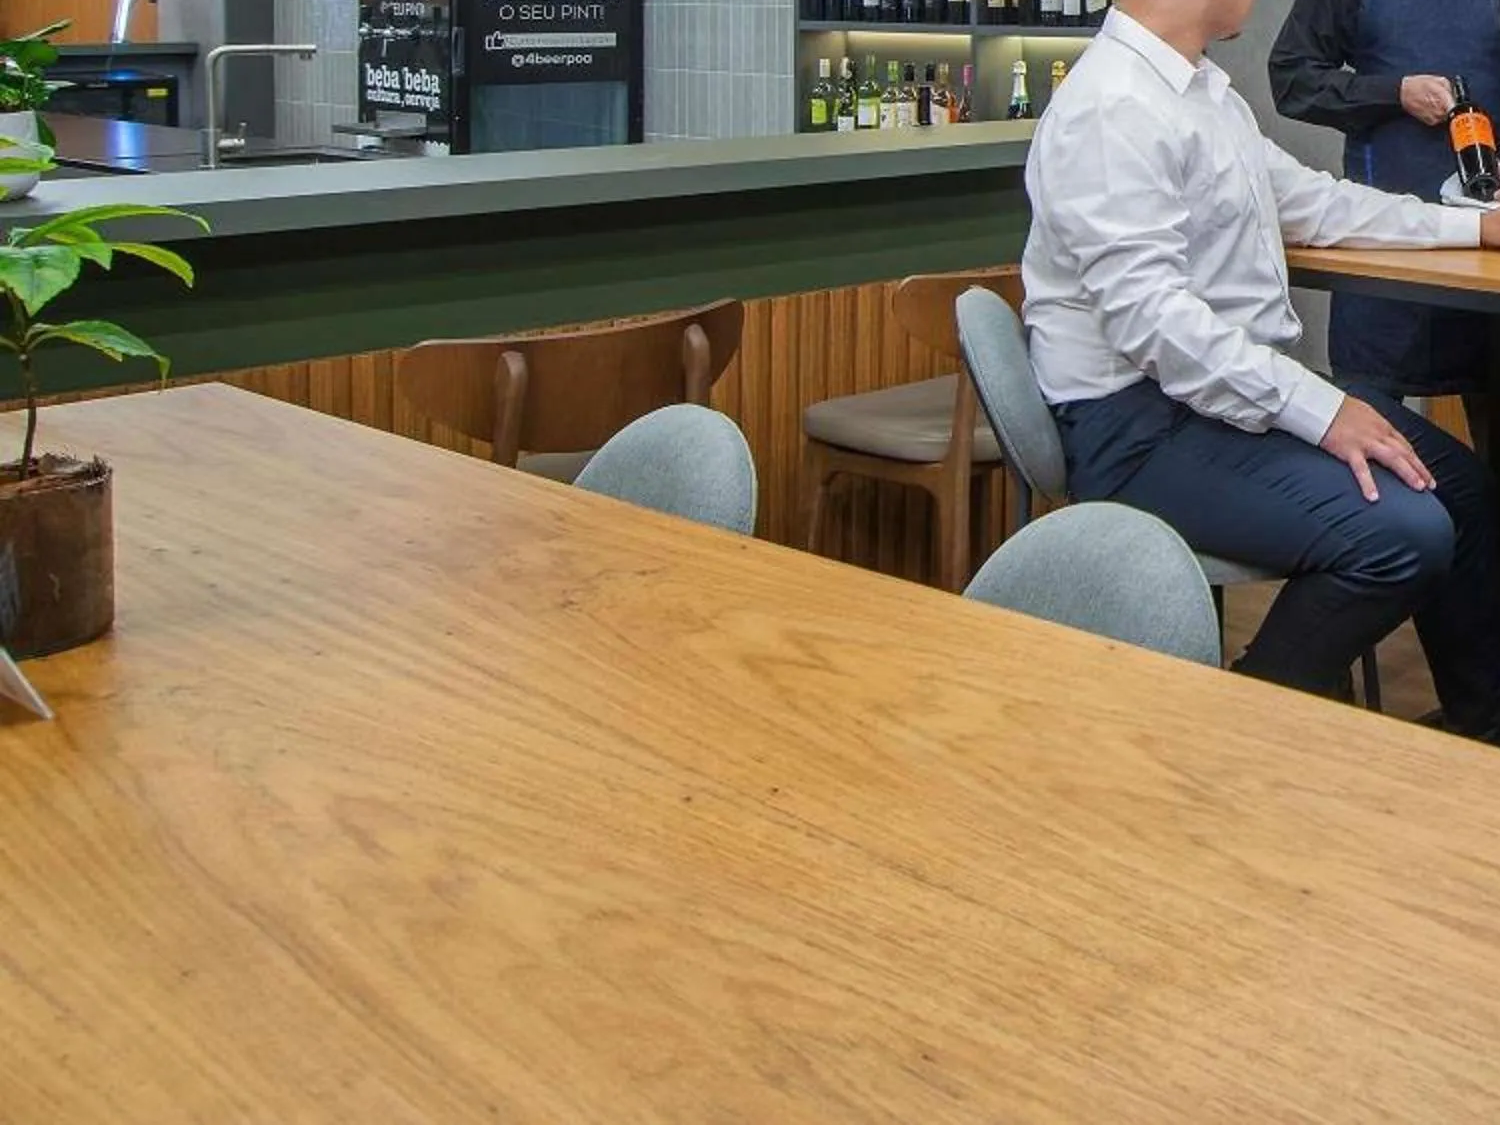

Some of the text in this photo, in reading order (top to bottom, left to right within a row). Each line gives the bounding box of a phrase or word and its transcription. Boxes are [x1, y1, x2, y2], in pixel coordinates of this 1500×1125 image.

[499, 4, 605, 20] O SEU PINT!
[365, 63, 441, 94] beba beba
